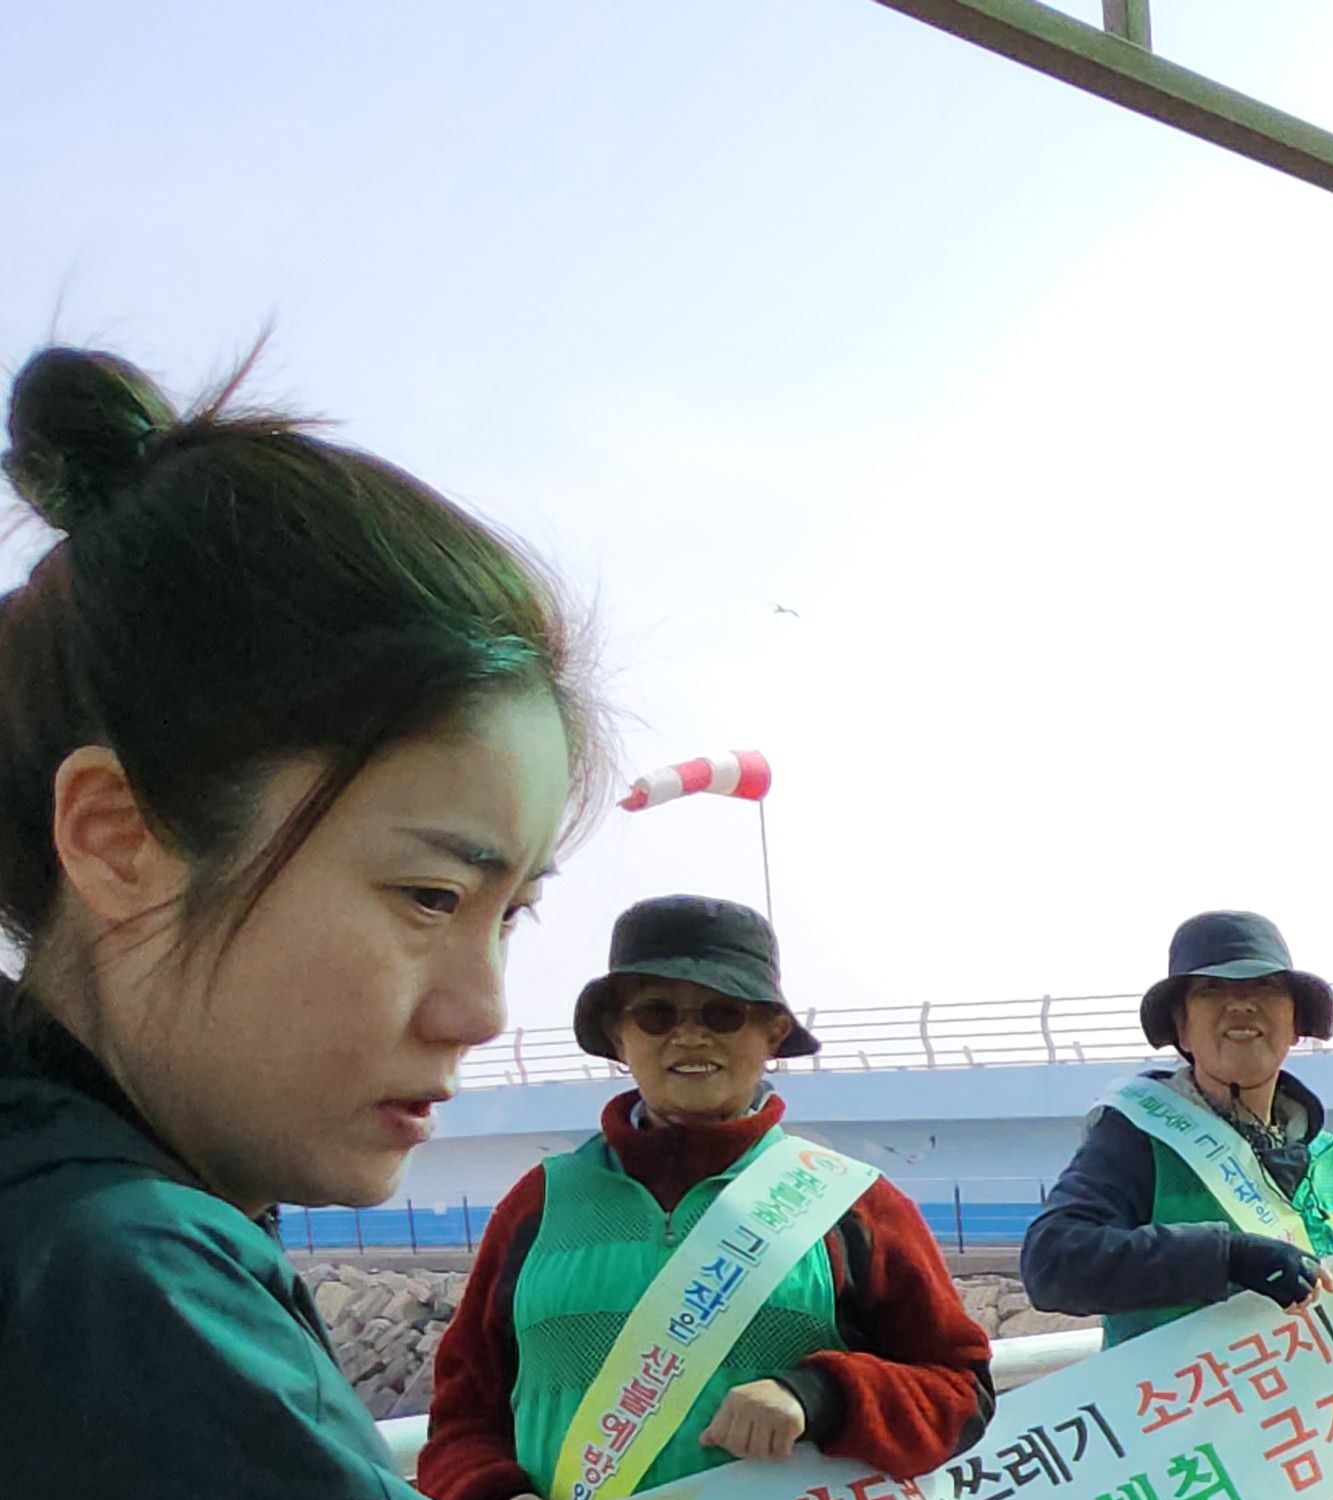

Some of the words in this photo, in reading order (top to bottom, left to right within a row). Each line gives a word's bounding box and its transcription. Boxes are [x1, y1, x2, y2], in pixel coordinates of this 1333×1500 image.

[1219, 1154, 1277, 1226] 시작은
[721, 1225, 766, 1263] 그
[668, 1256, 743, 1342] 시작은
